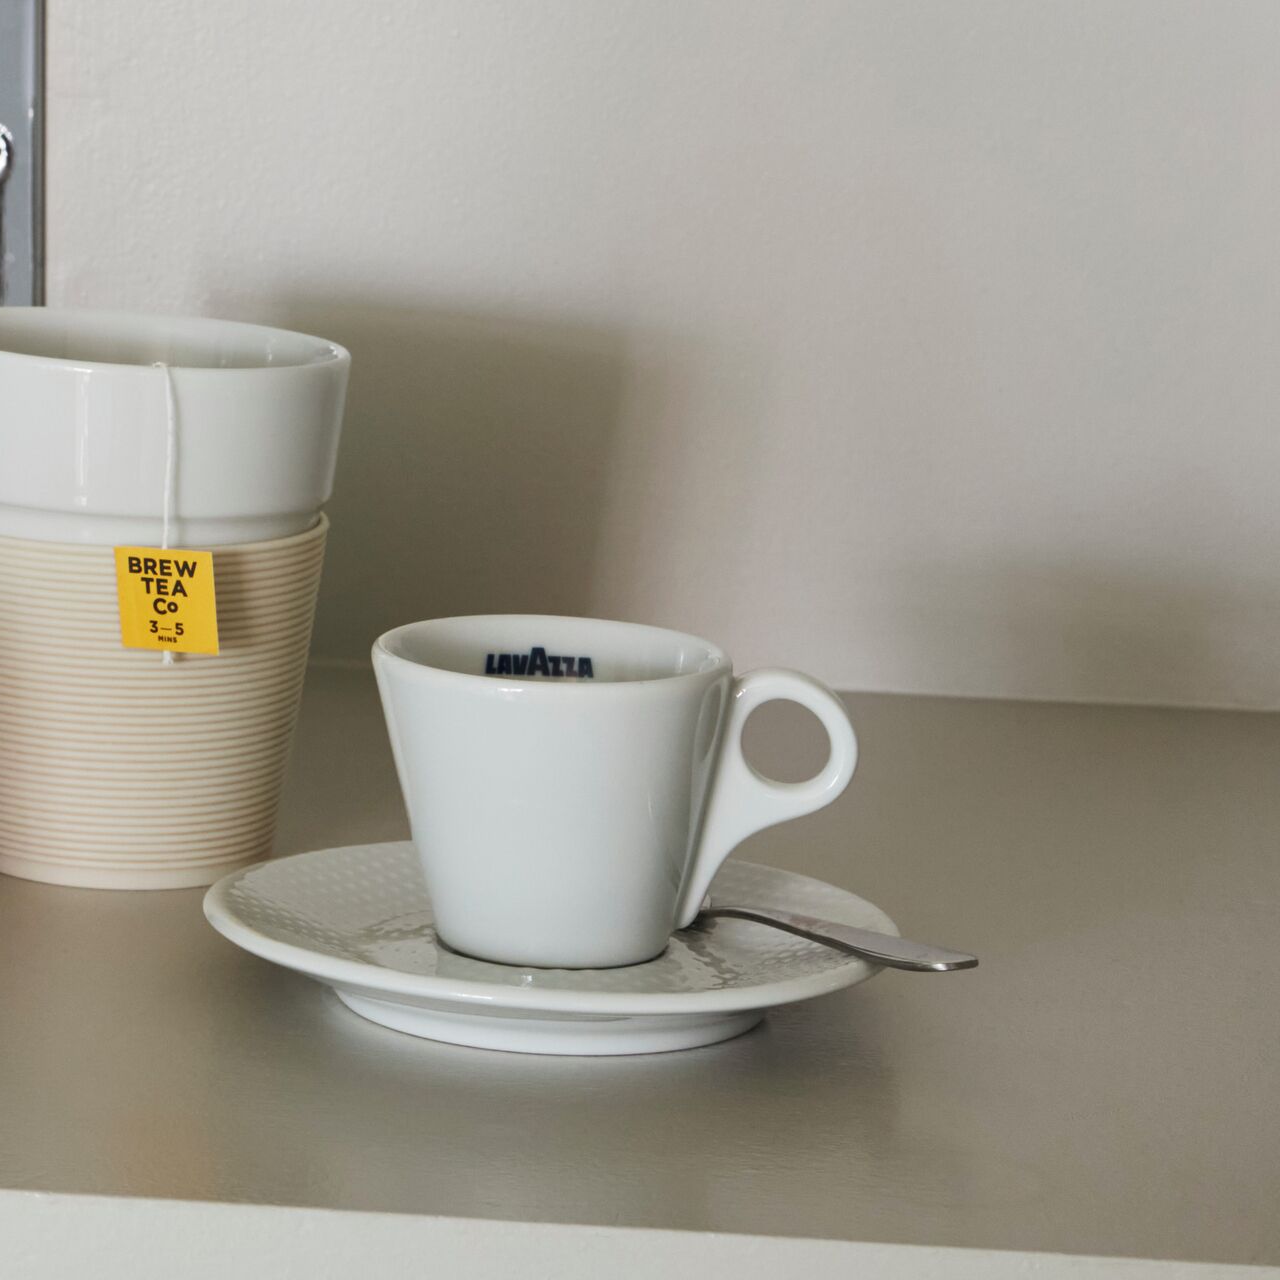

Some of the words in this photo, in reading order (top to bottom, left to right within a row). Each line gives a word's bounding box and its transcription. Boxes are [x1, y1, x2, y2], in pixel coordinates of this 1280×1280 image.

[128, 556, 197, 578] BREW
[141, 577, 188, 597] TEA
[152, 598, 179, 615] Co
[485, 647, 594, 678] LAVAZZA
